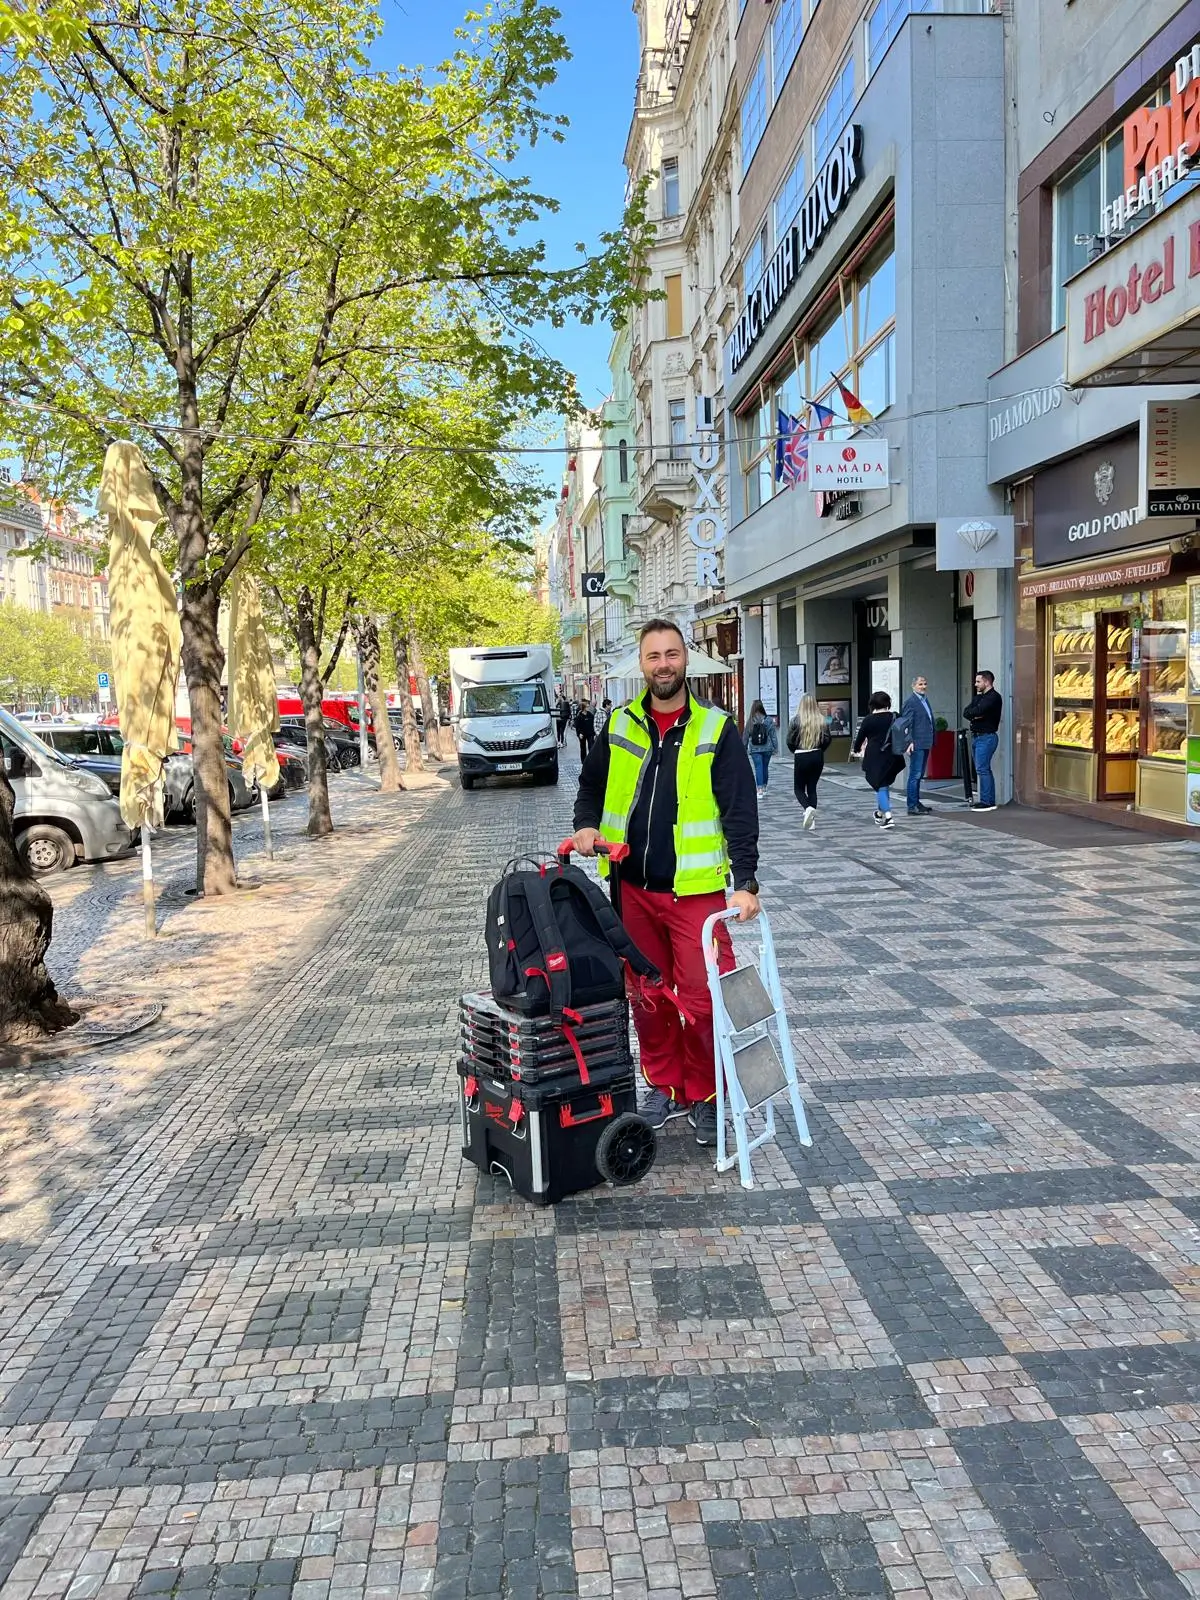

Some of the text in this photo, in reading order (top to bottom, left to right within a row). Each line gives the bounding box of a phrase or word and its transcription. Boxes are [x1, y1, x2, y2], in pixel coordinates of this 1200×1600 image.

[1101, 141, 1191, 235] THEATRE
[761, 226, 797, 326] KNIH
[800, 123, 861, 264] LUXOR
[1083, 235, 1175, 345] Hotel
[989, 387, 1062, 442] DIAMONDS
[688, 396, 726, 587] LUXOR
[815, 462, 884, 474] RAMADA
[836, 476, 864, 485] HOTEL
[1068, 505, 1140, 542] GOLD POINT
[1086, 568, 1122, 586] DIAMONDS
[1124, 560, 1167, 579] JEWELLERY
